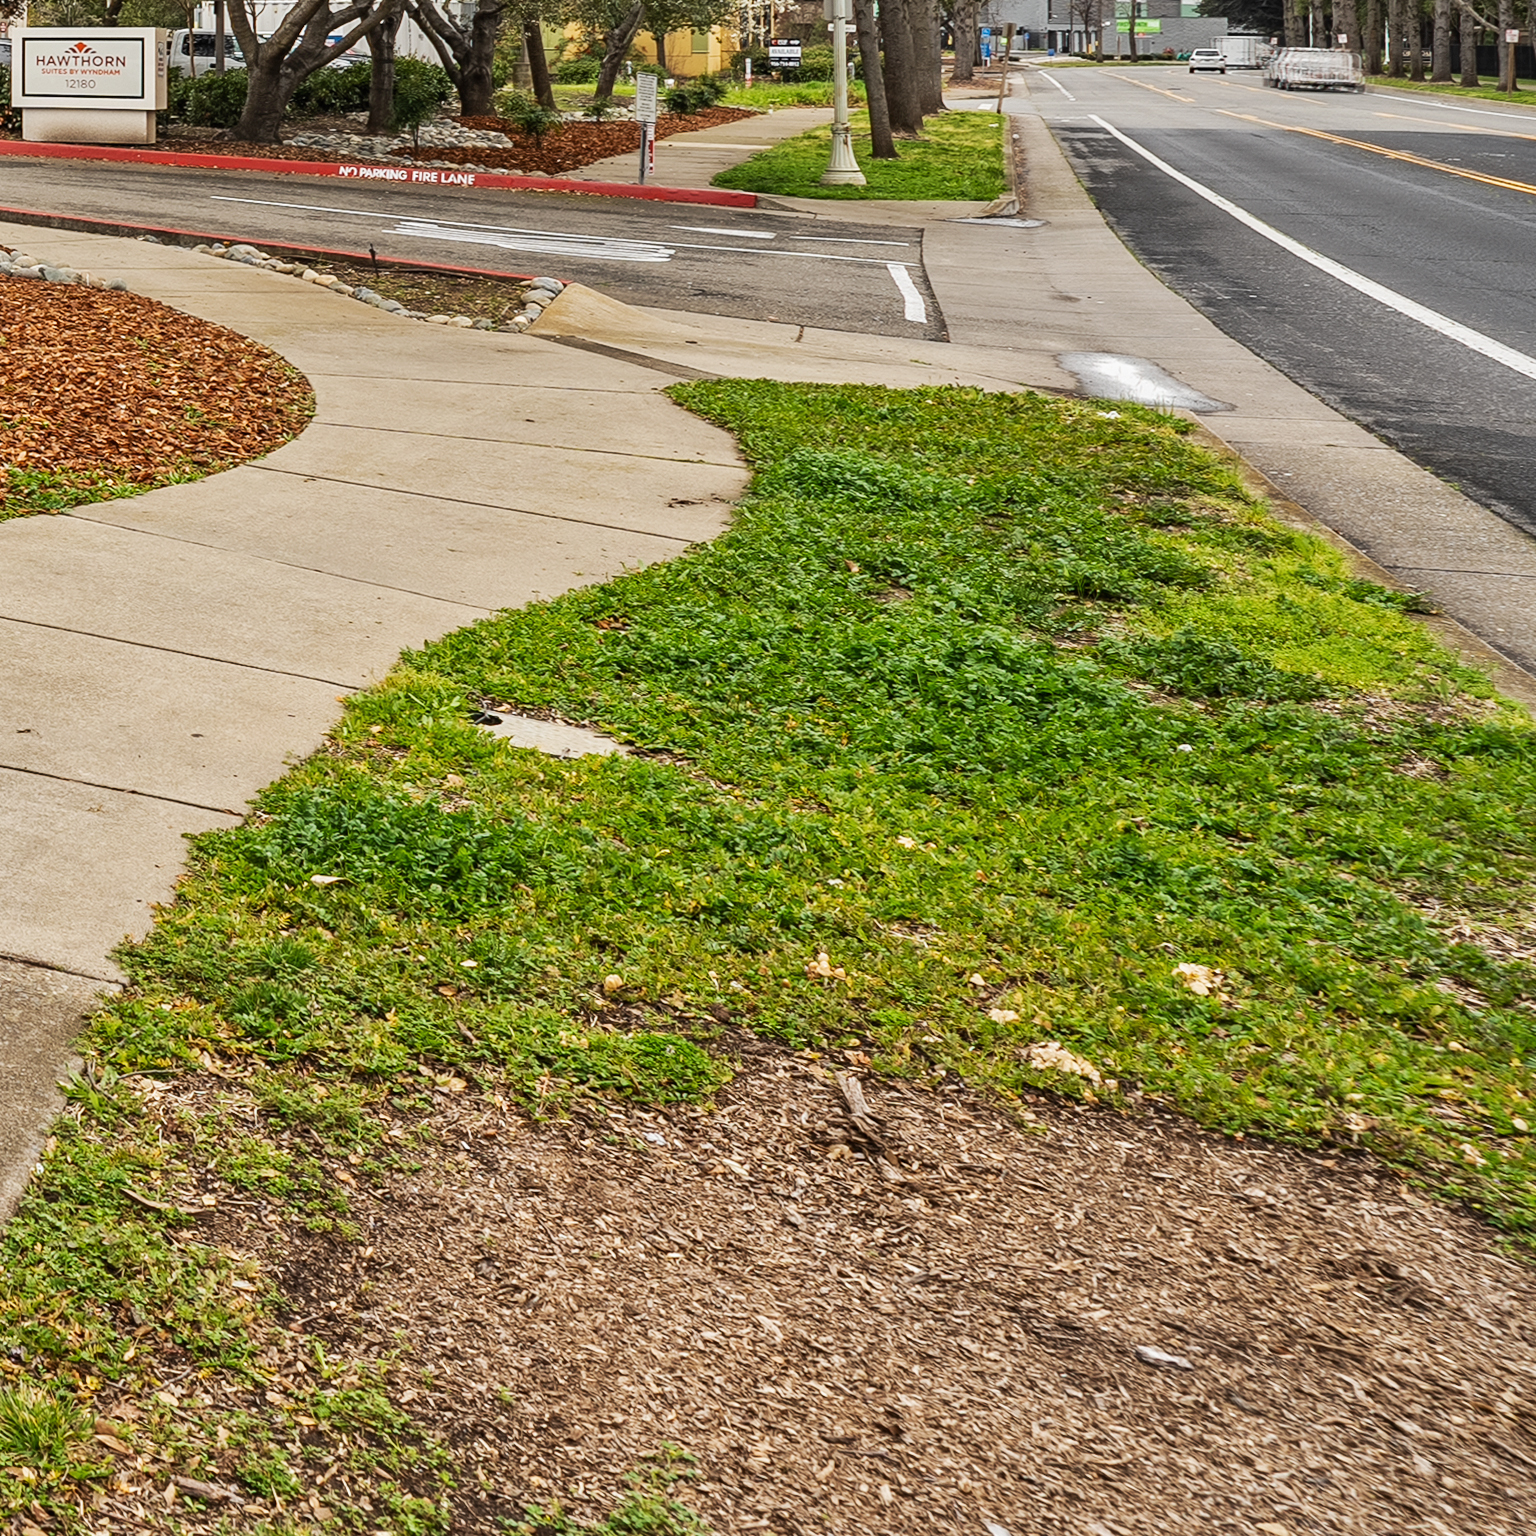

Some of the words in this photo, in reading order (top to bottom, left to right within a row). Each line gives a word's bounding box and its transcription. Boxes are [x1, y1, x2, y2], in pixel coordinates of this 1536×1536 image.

[36, 55, 126, 67] HAWTHORN
[65, 79, 96, 89] 12180
[339, 166, 357, 176] NO
[359, 167, 408, 180] PARKING
[412, 170, 438, 182] FIRE
[441, 173, 475, 184] LANE
